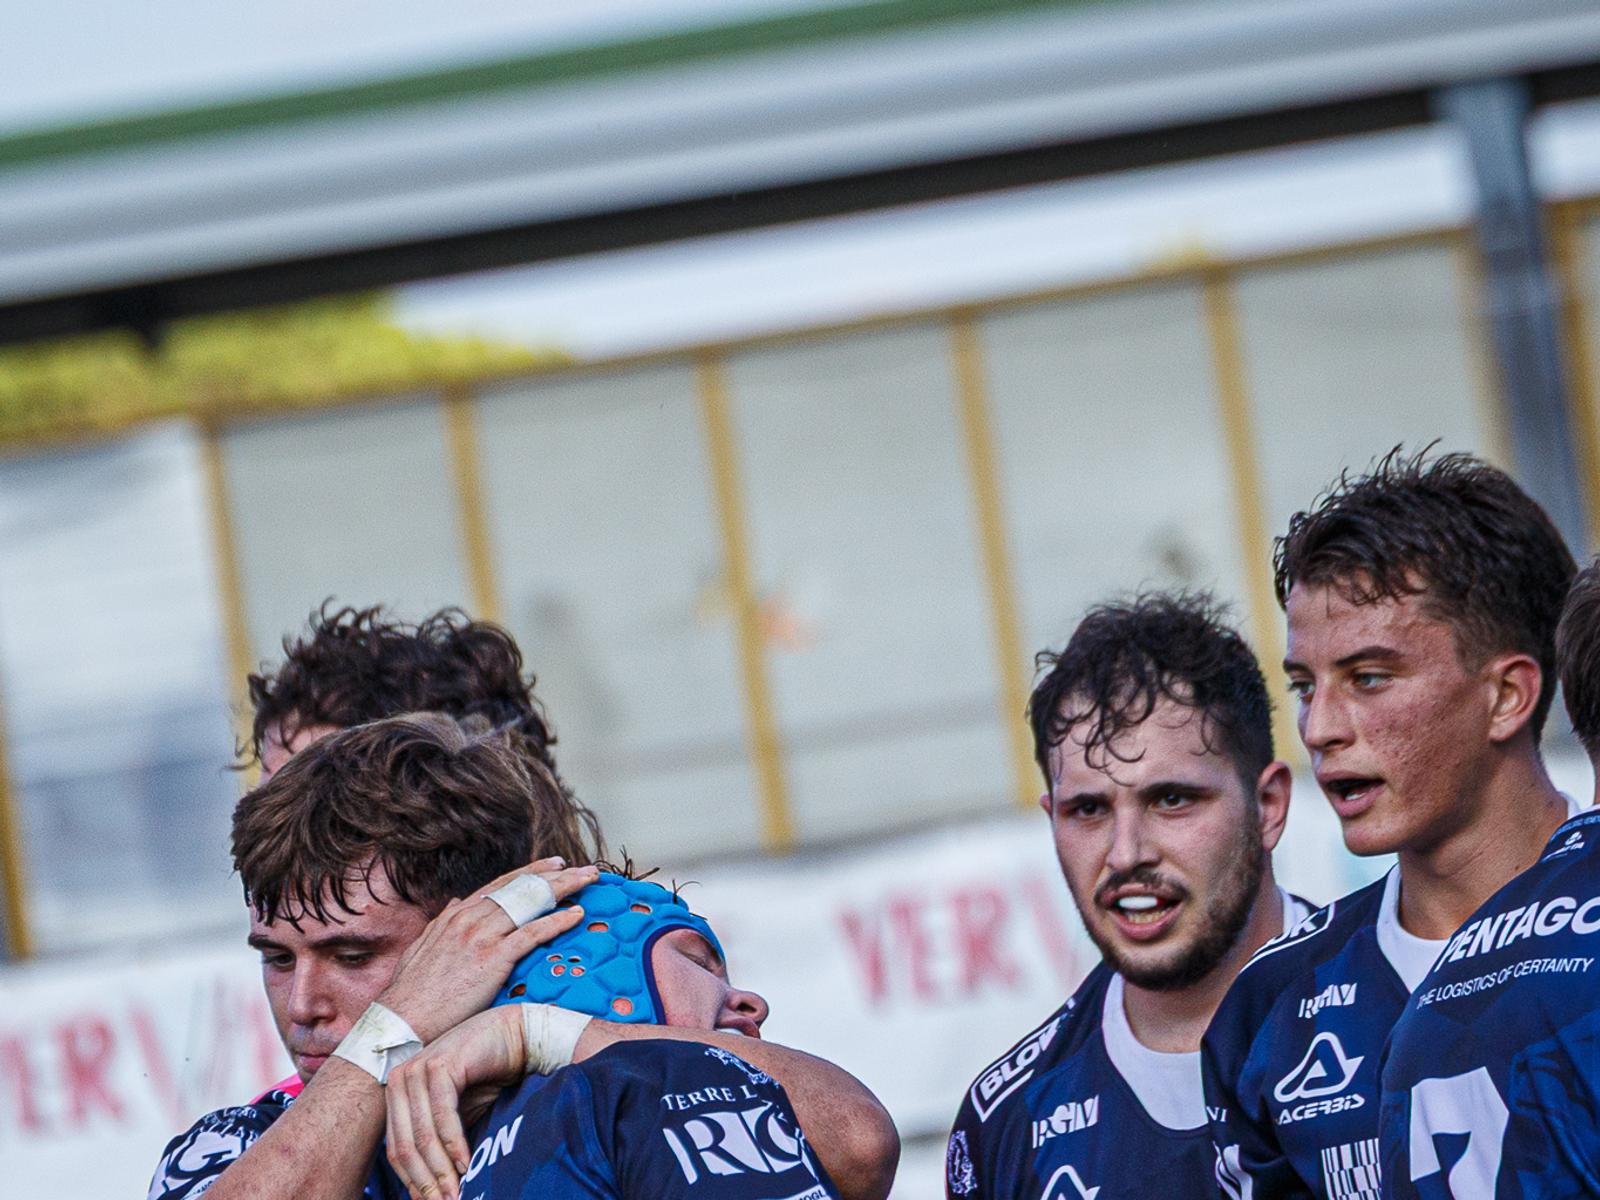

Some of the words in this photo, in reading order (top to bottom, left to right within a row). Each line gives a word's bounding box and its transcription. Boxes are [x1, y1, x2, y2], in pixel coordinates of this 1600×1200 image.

[1435, 972, 1502, 1001] LOGISTICS
[1499, 964, 1515, 984] OF
[1513, 957, 1595, 979] CERTAINTY
[660, 1086, 737, 1110] TERRE
[1276, 1093, 1366, 1125] ACERBIS
